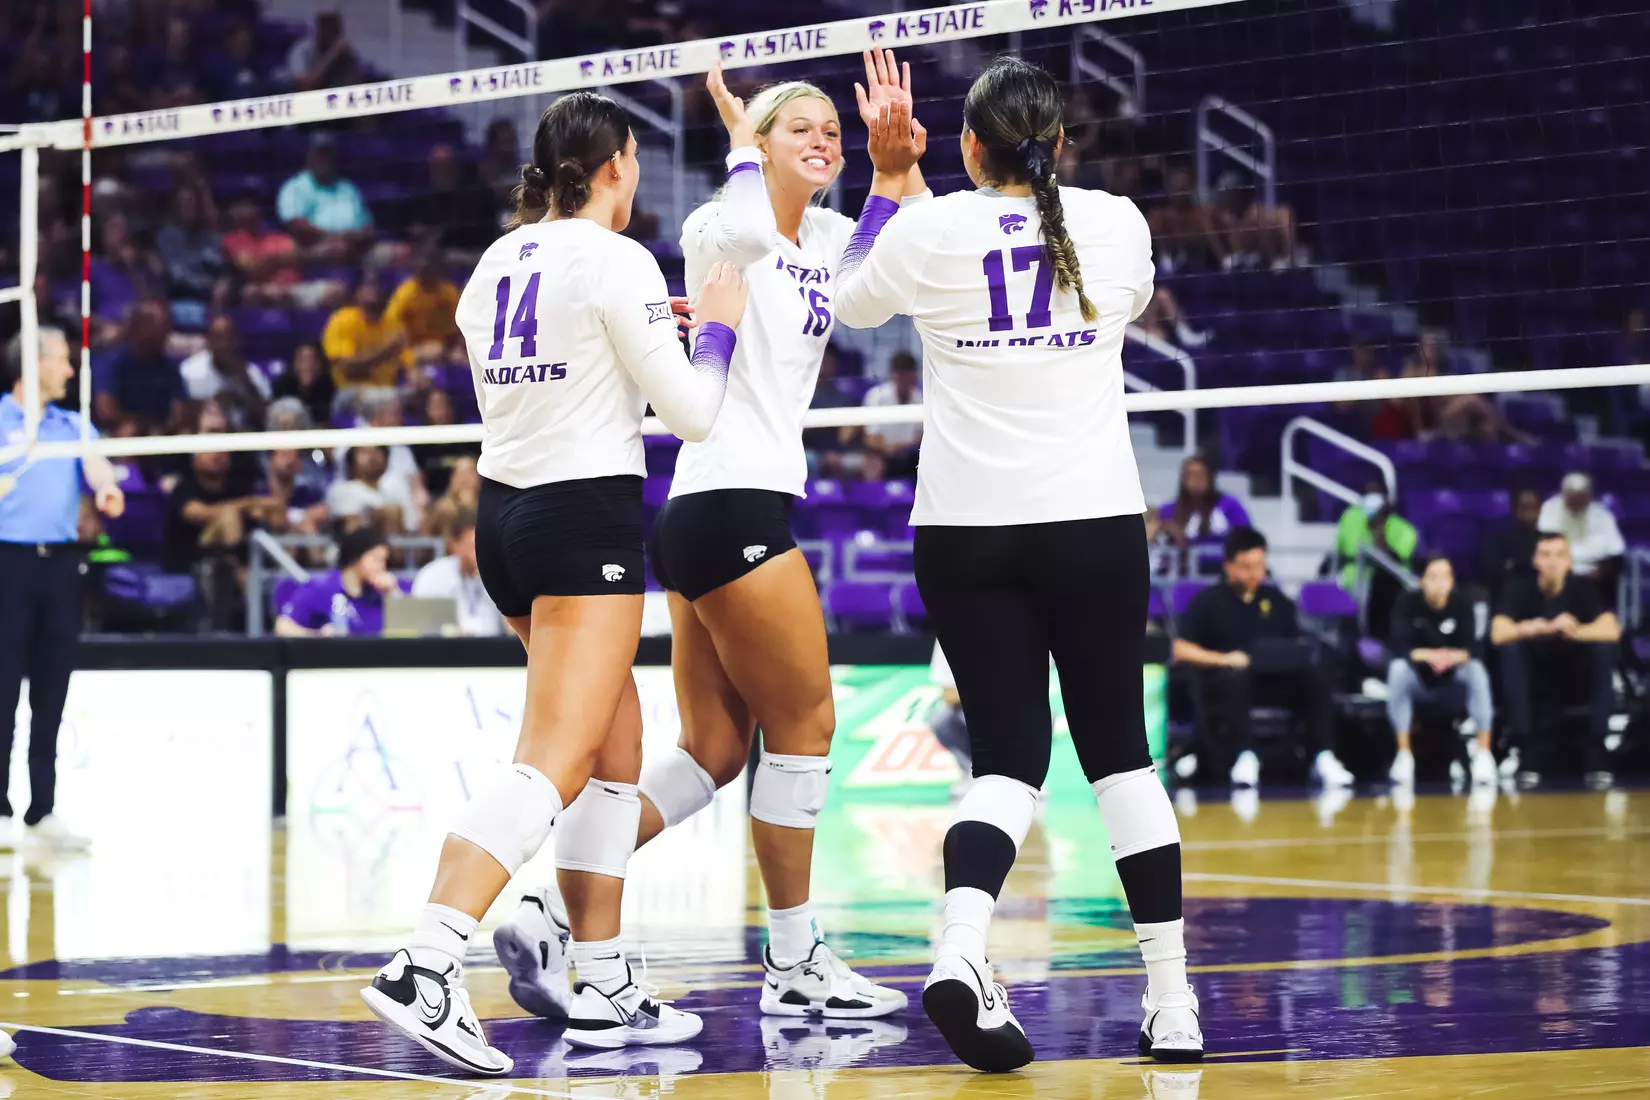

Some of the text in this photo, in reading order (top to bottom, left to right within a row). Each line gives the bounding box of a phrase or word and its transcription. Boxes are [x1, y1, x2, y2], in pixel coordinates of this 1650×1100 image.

[895, 6, 986, 39] K-STATE
[744, 28, 828, 59] K-STATE
[603, 49, 681, 77] K-STATE
[470, 66, 542, 94] K-STATE
[346, 84, 415, 109] K-STATE
[982, 244, 1056, 332] 17
[488, 272, 541, 360] 14
[799, 286, 831, 337] 16
